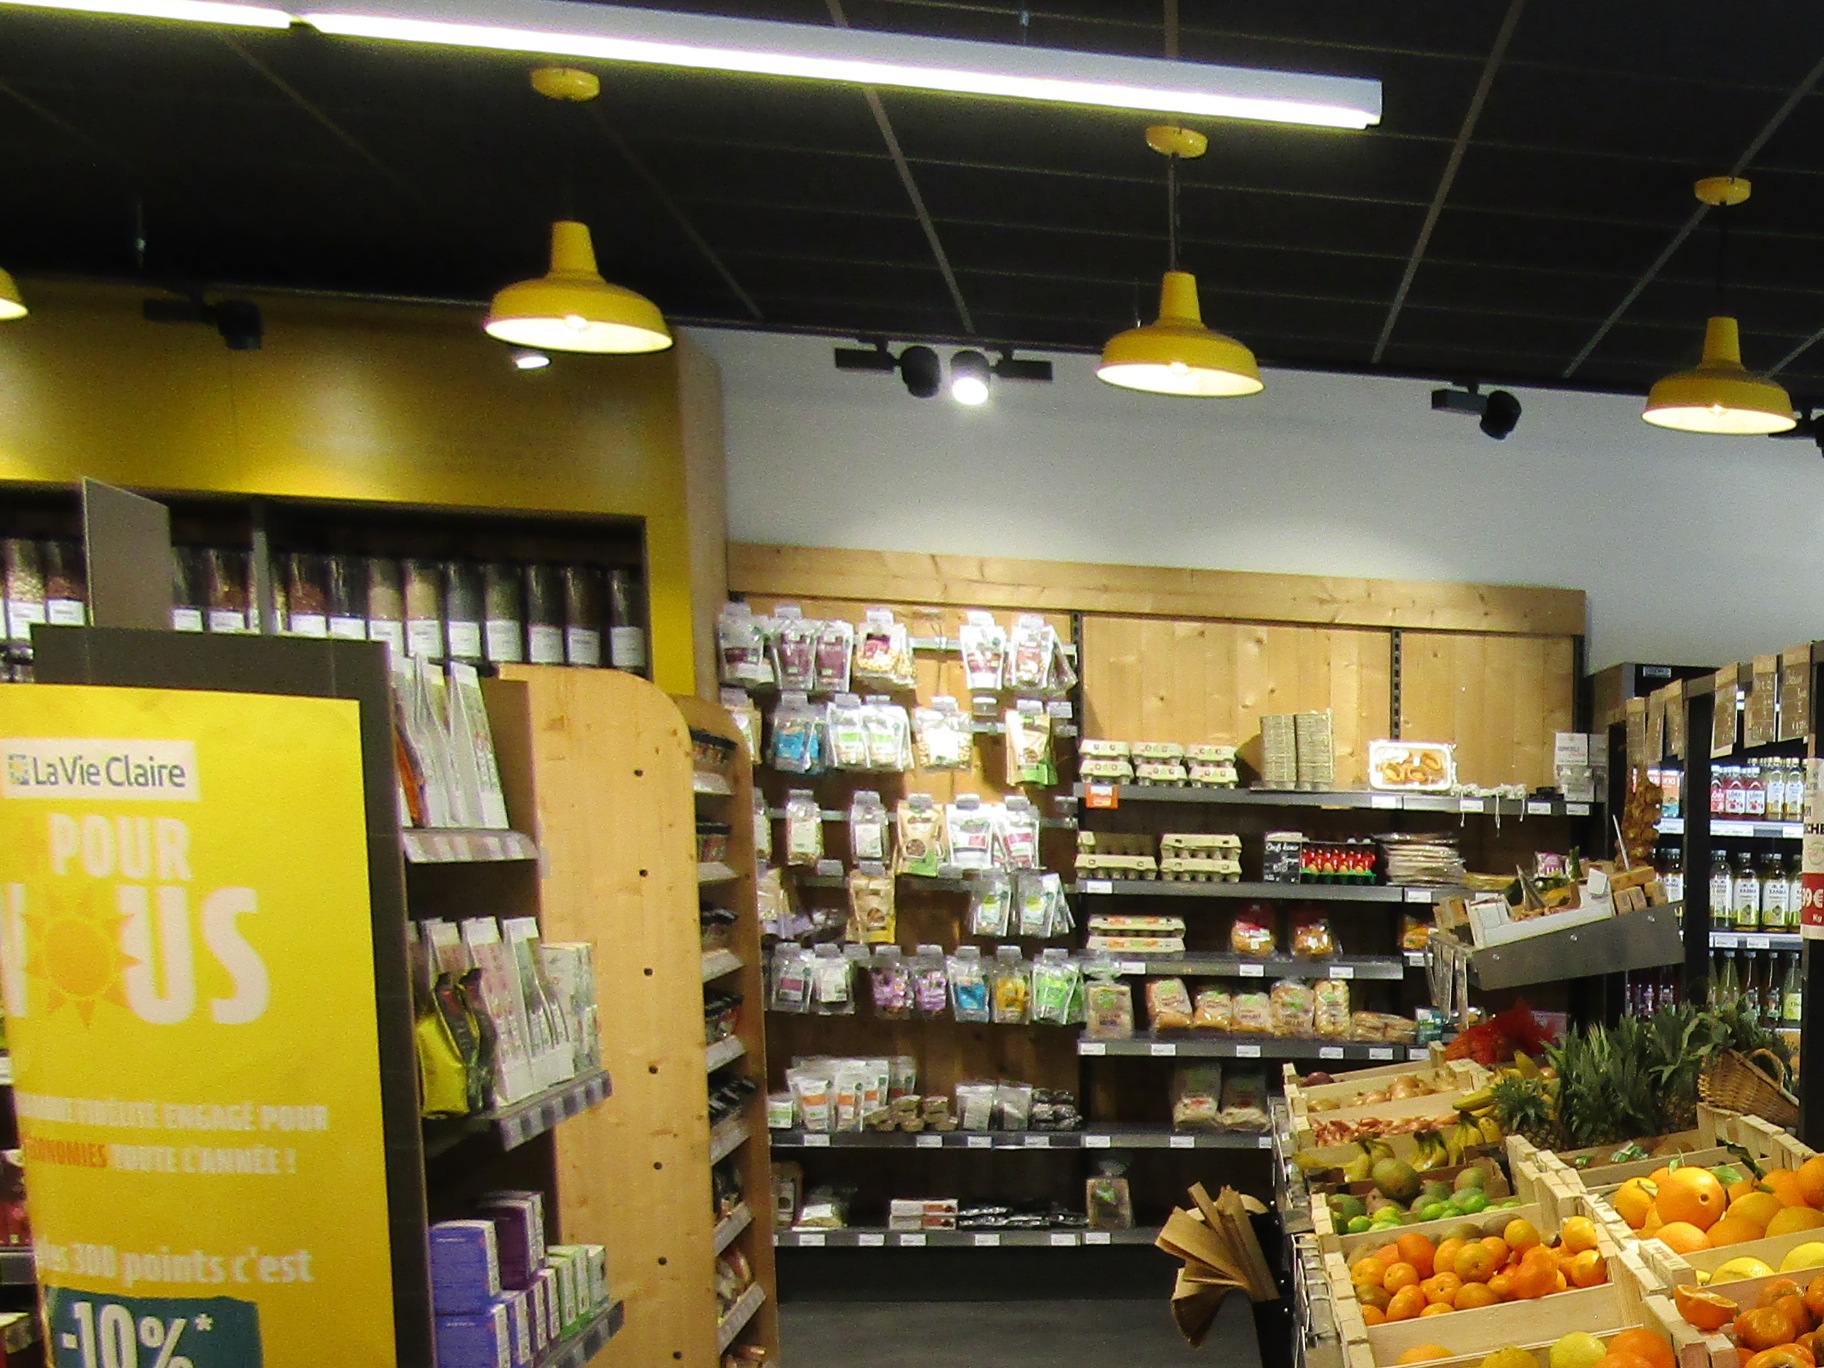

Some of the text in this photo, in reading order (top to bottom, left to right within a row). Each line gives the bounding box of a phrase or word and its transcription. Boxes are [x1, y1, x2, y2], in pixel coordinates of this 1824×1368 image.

[33, 755, 187, 788] La Vie Claire
[47, 813, 194, 881] POUR
[259, 1105, 329, 1132] POUR
[71, 1242, 118, 1278] 300
[122, 1246, 226, 1288] points
[231, 1247, 315, 1284] c'est
